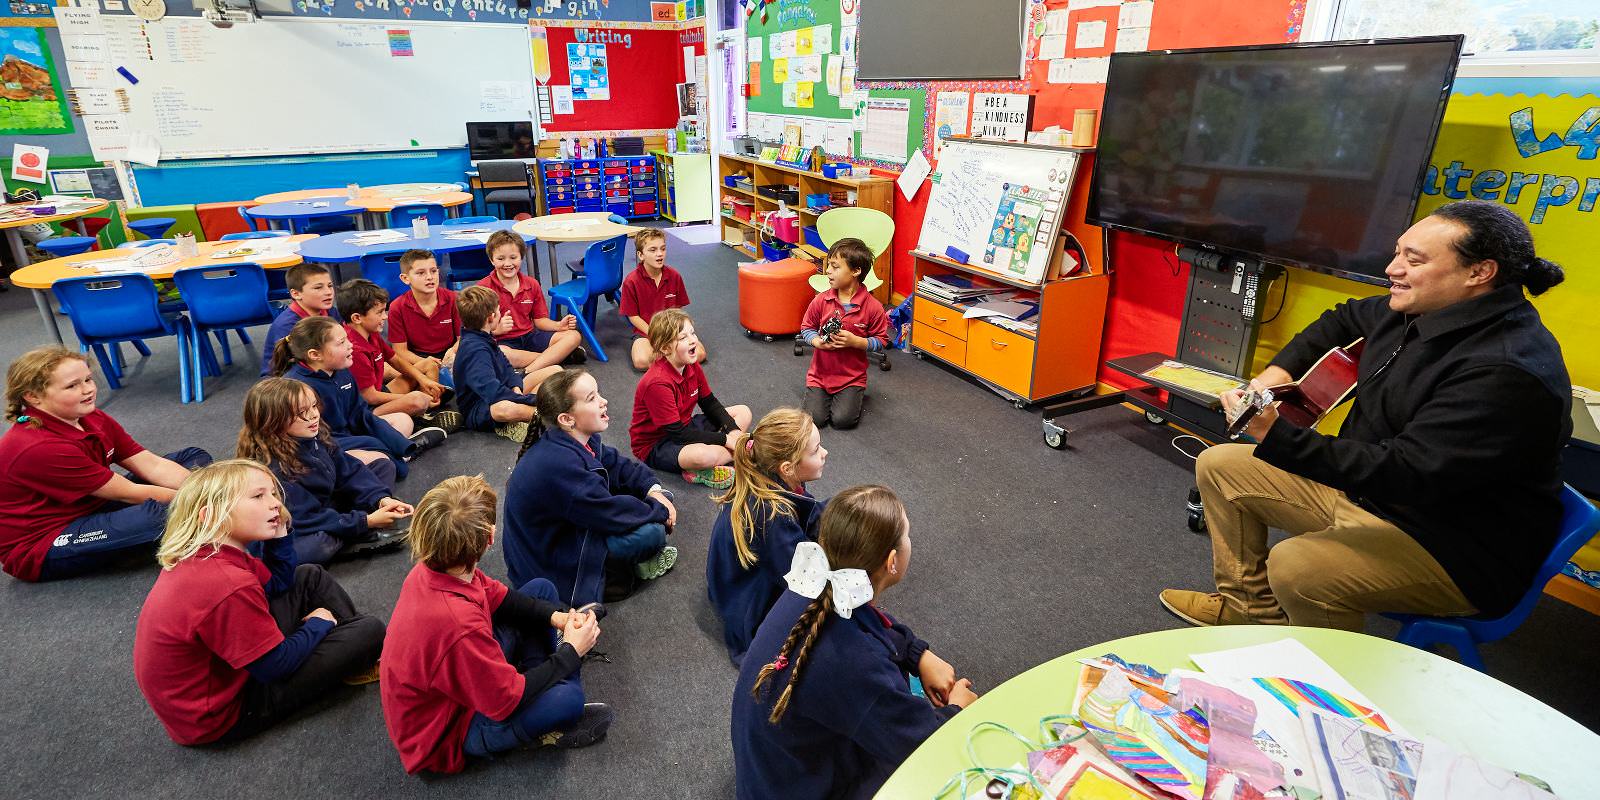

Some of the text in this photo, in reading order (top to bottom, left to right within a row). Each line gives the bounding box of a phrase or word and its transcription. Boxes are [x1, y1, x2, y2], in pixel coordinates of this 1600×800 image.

[544, 0, 599, 17] Bgin
[658, 9, 670, 18] ed
[574, 28, 632, 49] Writing
[985, 97, 1007, 108] #BE A
[985, 111, 1025, 124] KINDNESS
[982, 125, 1006, 137] NINJA
[1509, 106, 1600, 160] L4
